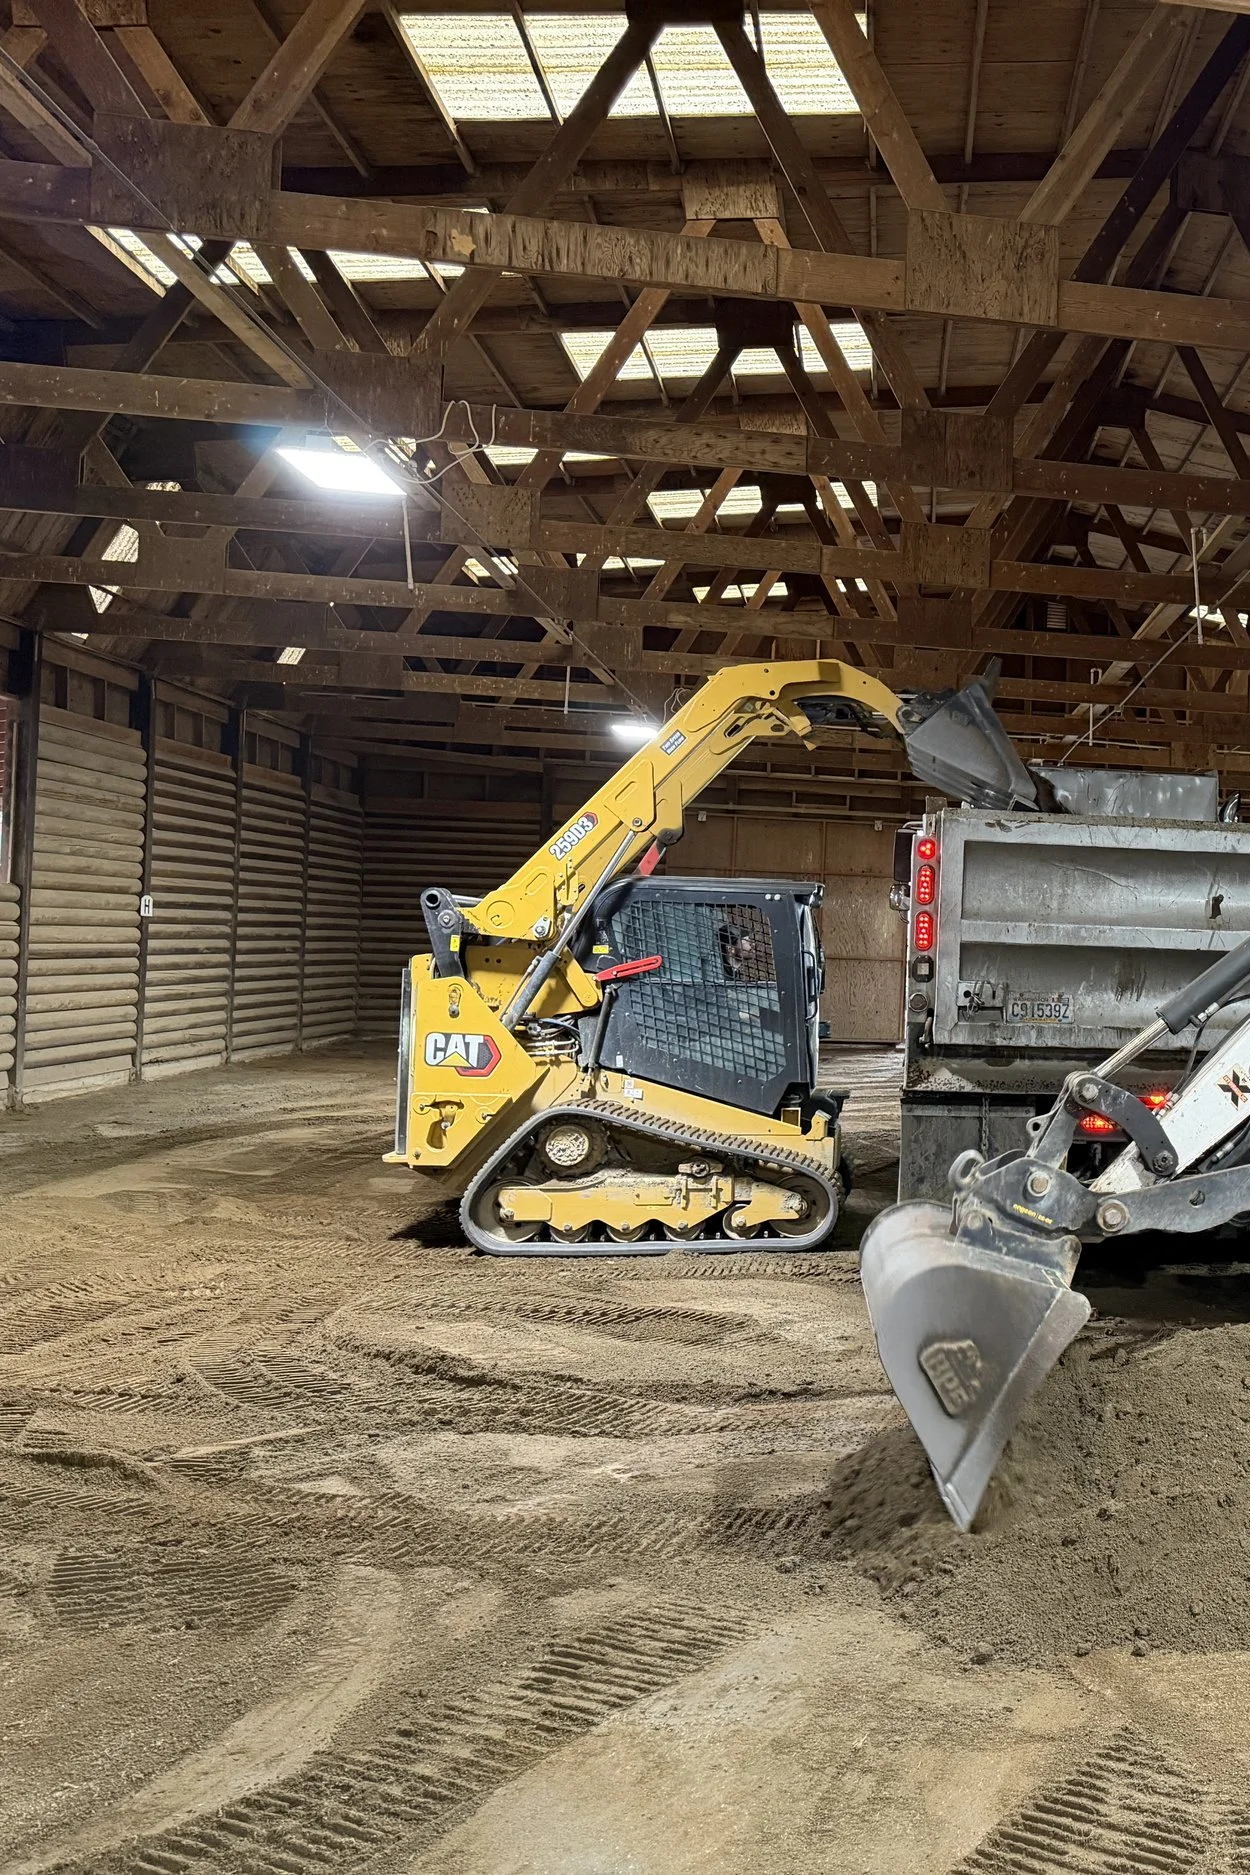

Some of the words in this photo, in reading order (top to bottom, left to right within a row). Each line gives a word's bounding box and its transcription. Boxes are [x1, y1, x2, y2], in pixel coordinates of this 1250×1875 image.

[549, 815, 595, 861] 259D3
[144, 898, 151, 915] H
[1011, 1002, 1070, 1020] C91539Z
[425, 1032, 484, 1068] CAT
